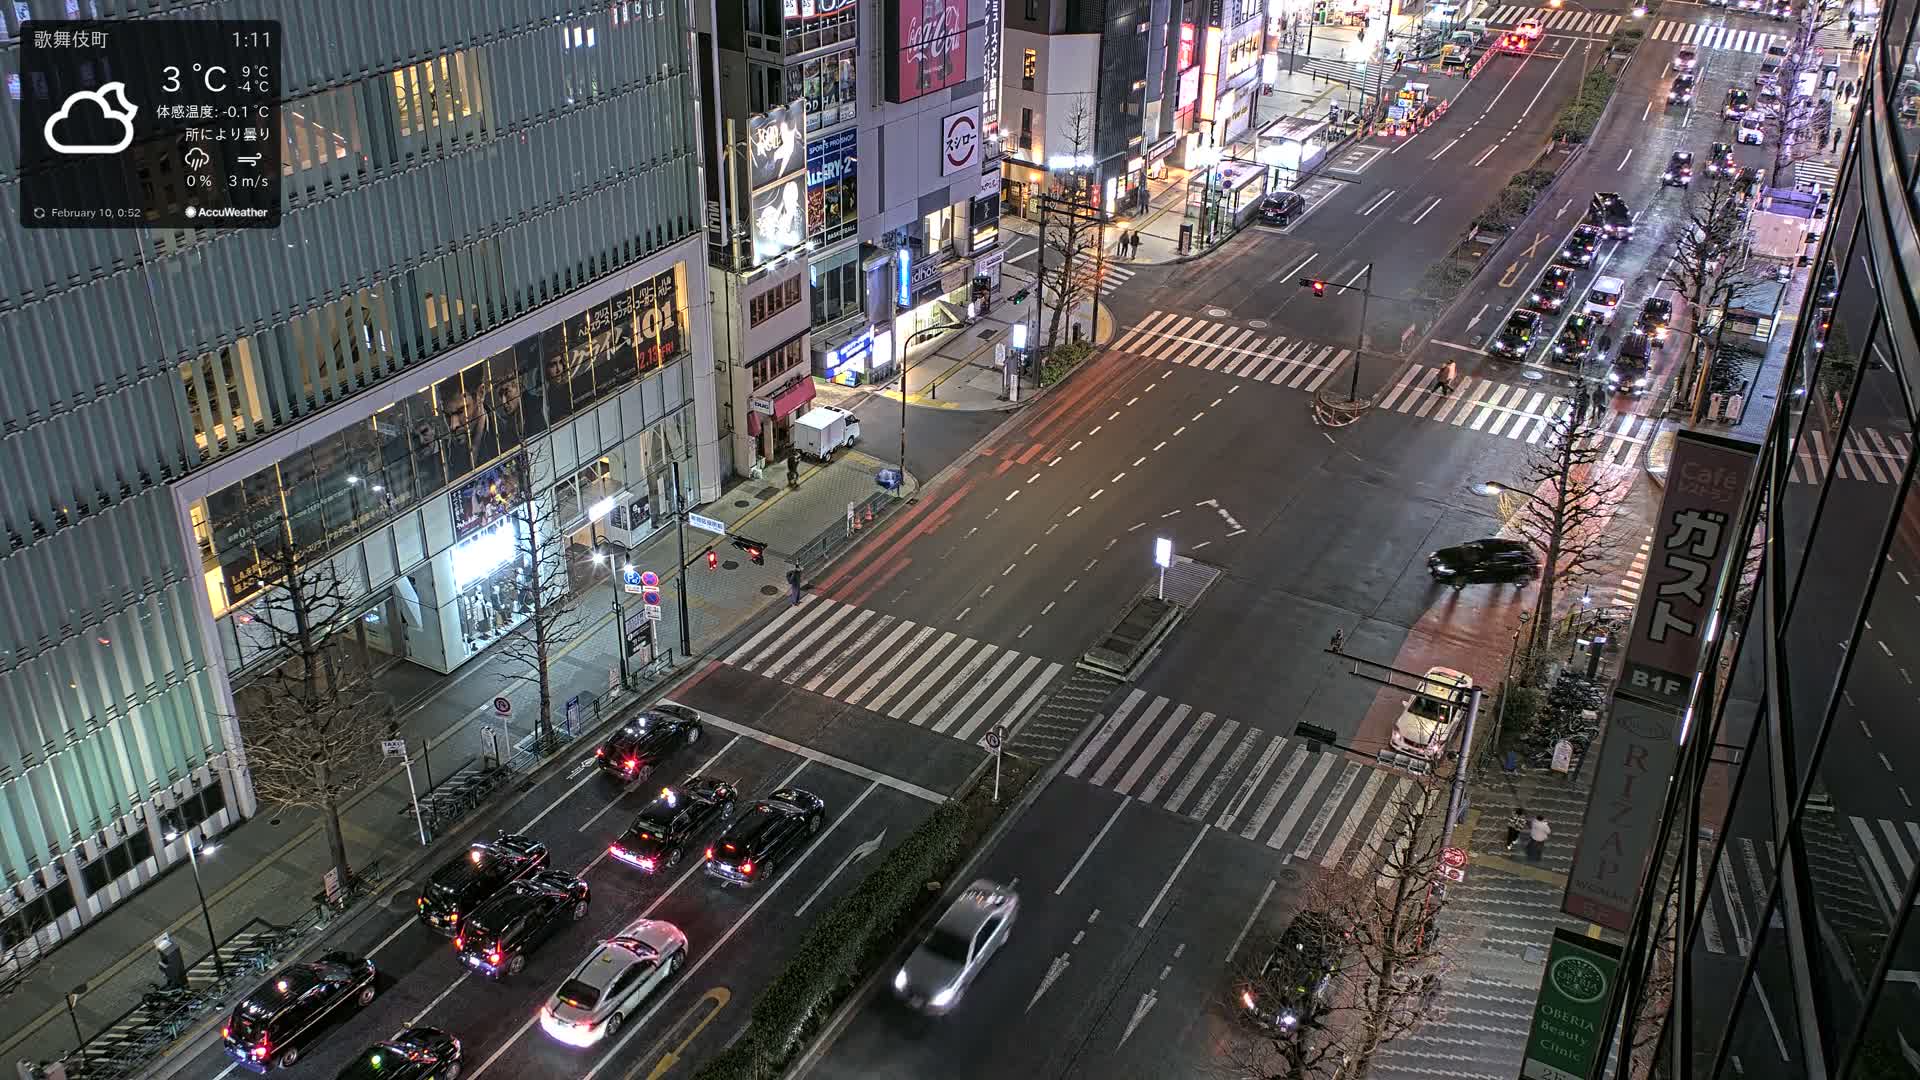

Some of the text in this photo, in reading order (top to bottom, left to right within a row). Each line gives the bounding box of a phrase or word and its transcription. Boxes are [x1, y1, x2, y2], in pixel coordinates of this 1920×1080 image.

[945, 133, 977, 153] スシロー
[709, 200, 721, 233] MUJI
[1648, 509, 1727, 642] ガスト
[1631, 669, 1681, 696] B1F
[1596, 743, 1649, 882] RIZAP
[1541, 1004, 1594, 1032] OBERIA
[1541, 1020, 1586, 1048] Beauty
[1540, 1039, 1580, 1061] Clinic
